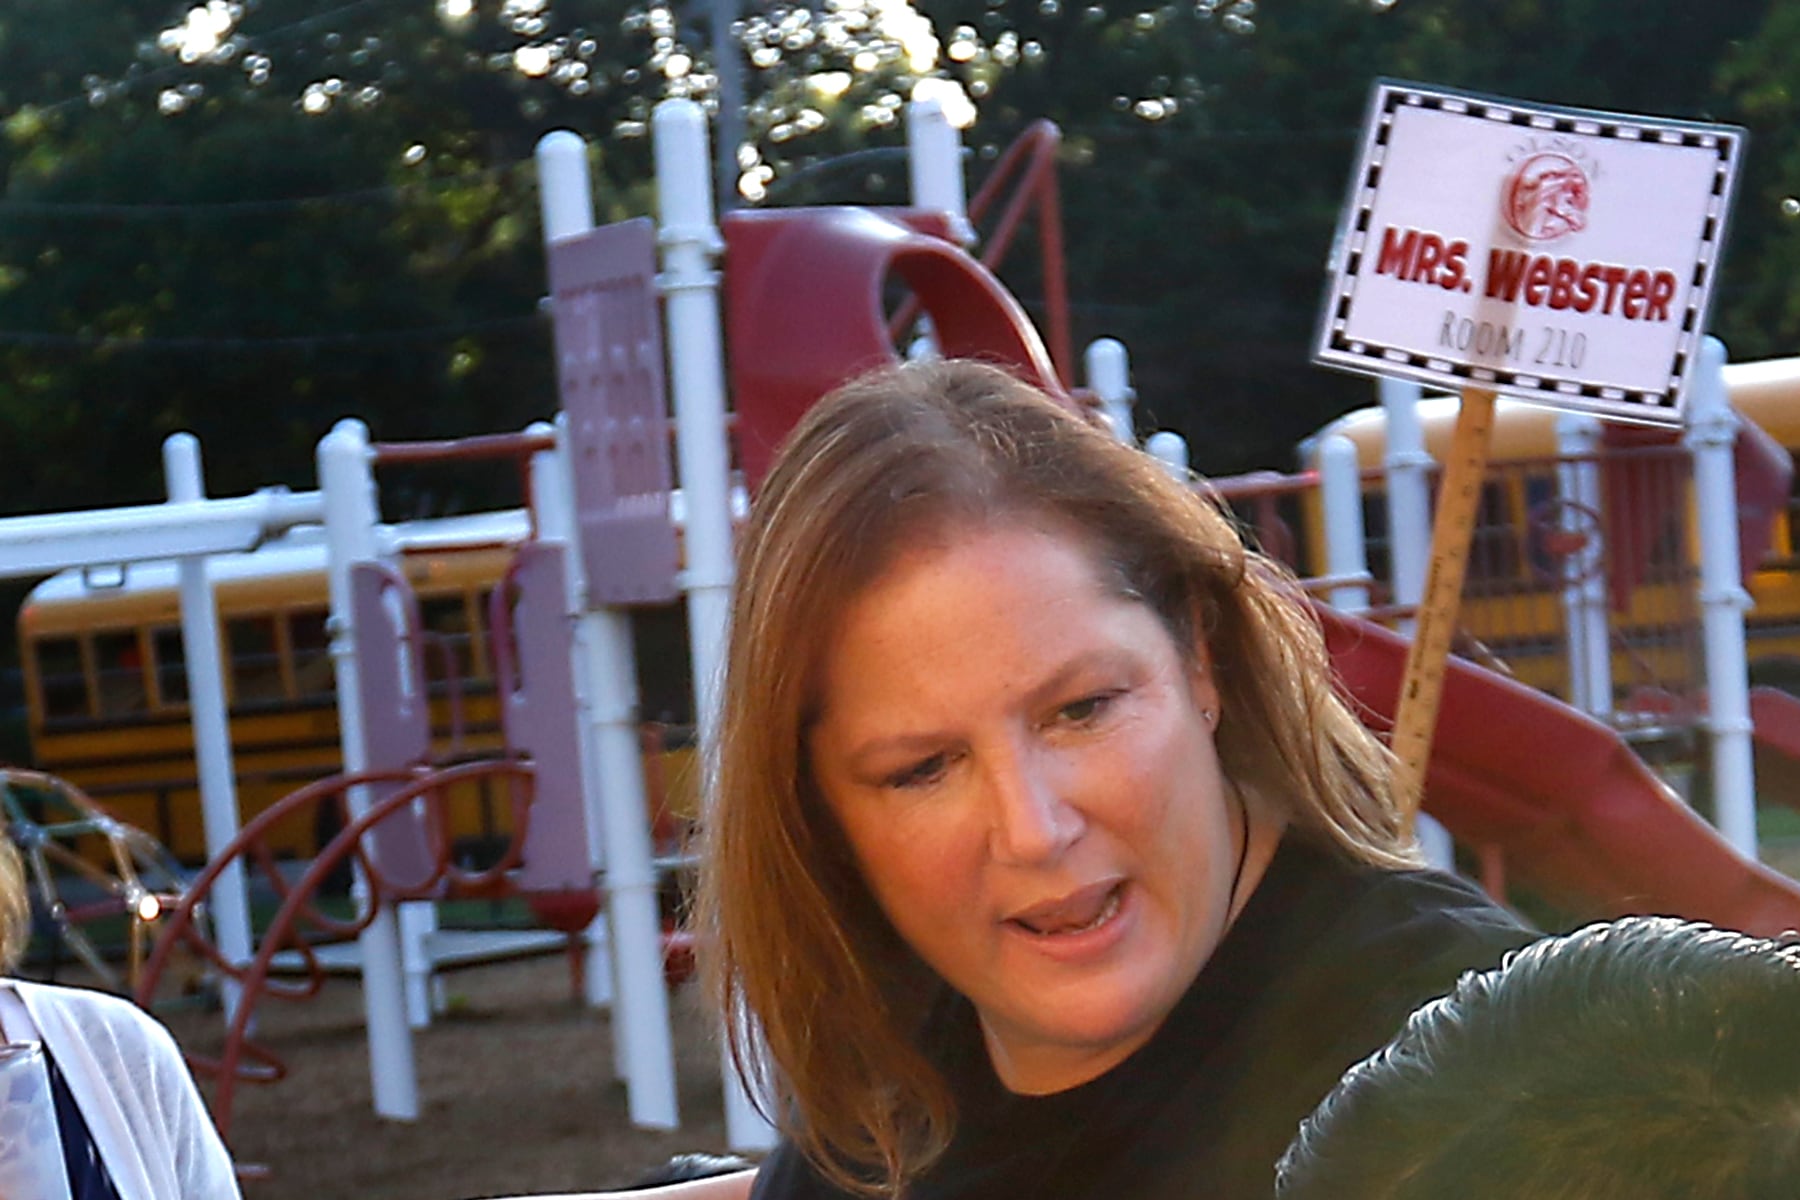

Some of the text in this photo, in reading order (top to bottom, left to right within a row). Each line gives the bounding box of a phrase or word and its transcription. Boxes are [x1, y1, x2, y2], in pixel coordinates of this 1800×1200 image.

[1376, 227, 1473, 295] MRS.
[1439, 310, 1588, 369] ROOM 210
